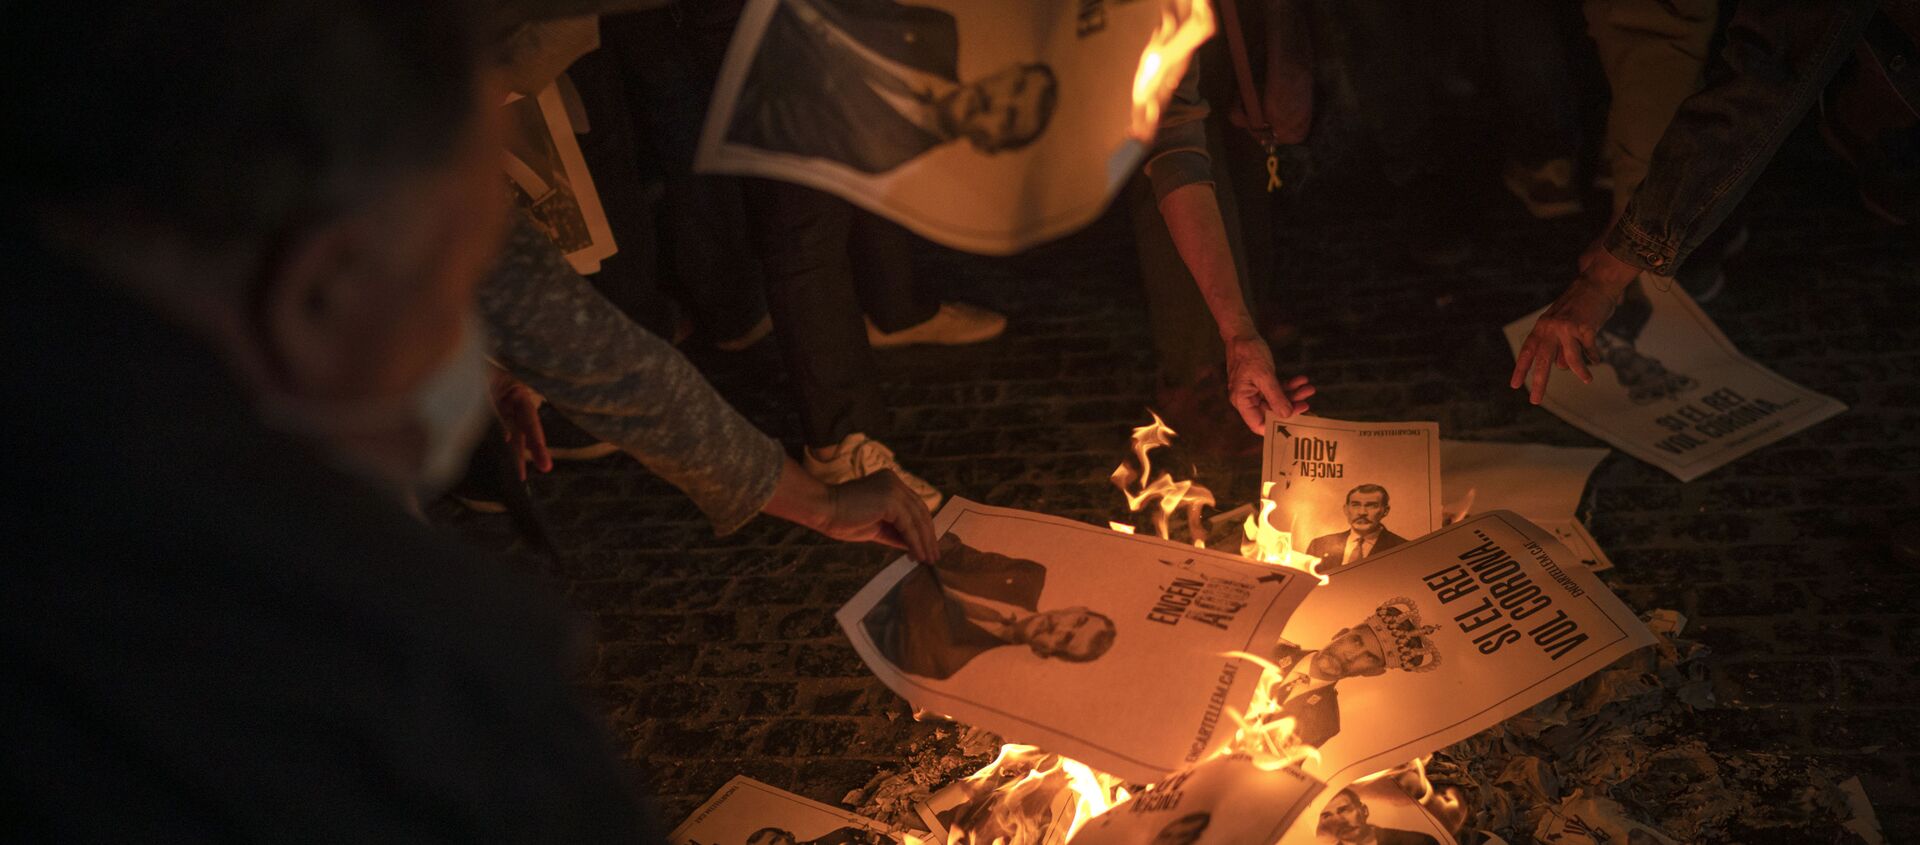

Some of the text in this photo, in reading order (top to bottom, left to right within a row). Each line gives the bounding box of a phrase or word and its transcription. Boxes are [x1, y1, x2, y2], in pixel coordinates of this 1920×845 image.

[1656, 415, 1688, 433] SI
[1678, 404, 1712, 424] EL
[1294, 437, 1337, 466] AQUÍ
[1301, 461, 1343, 482] ENCÉN
[1523, 540, 1584, 599] ENCARTELLEM.CAT
[1146, 577, 1205, 626] ENCÉN
[1422, 564, 1521, 656] SI EL REI
[1528, 609, 1589, 661] VOL
[1185, 662, 1238, 763] ENCARTELLEM.CAT
